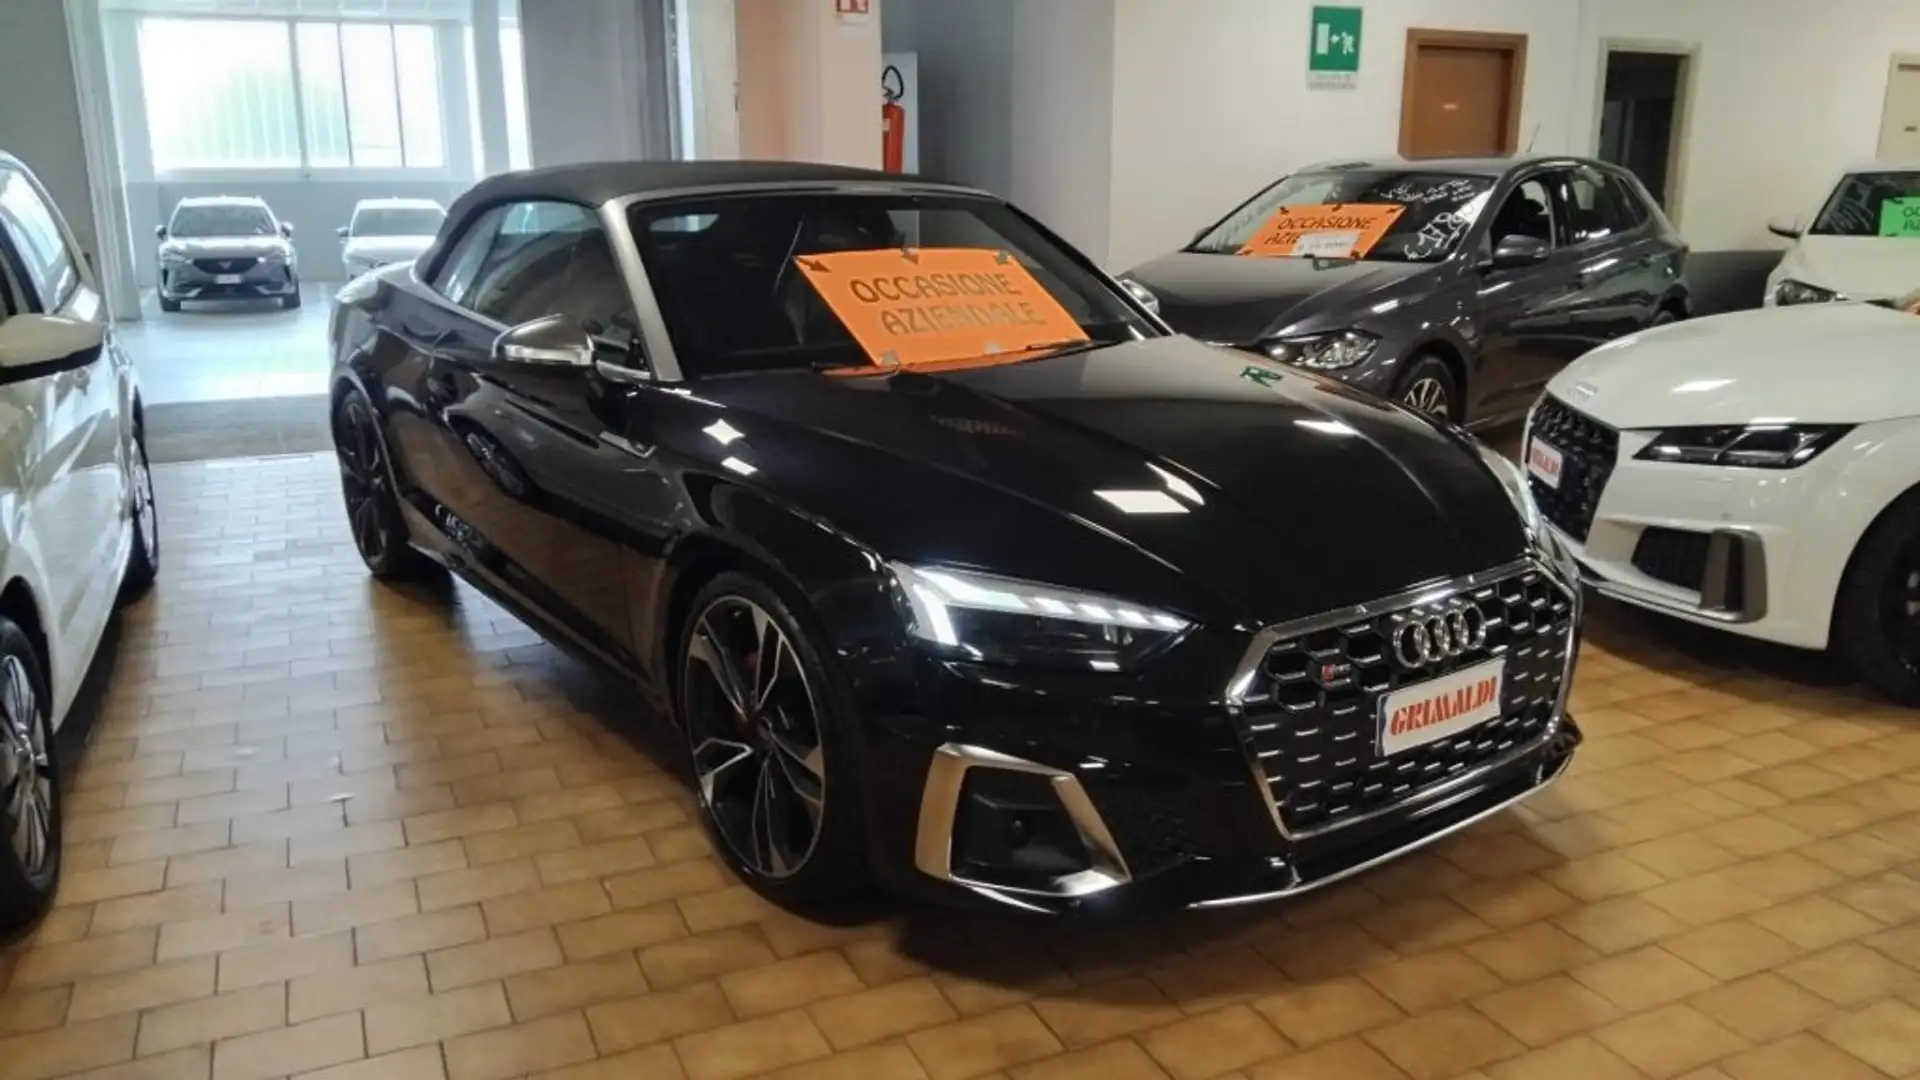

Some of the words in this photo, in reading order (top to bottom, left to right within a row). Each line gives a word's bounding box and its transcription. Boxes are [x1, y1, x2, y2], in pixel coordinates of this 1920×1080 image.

[1277, 216, 1377, 230] OCCASIONE
[850, 273, 1021, 303] OCCASIONE
[881, 302, 1046, 336] AZIENDALE
[1390, 676, 1497, 735] GRIMALDI
